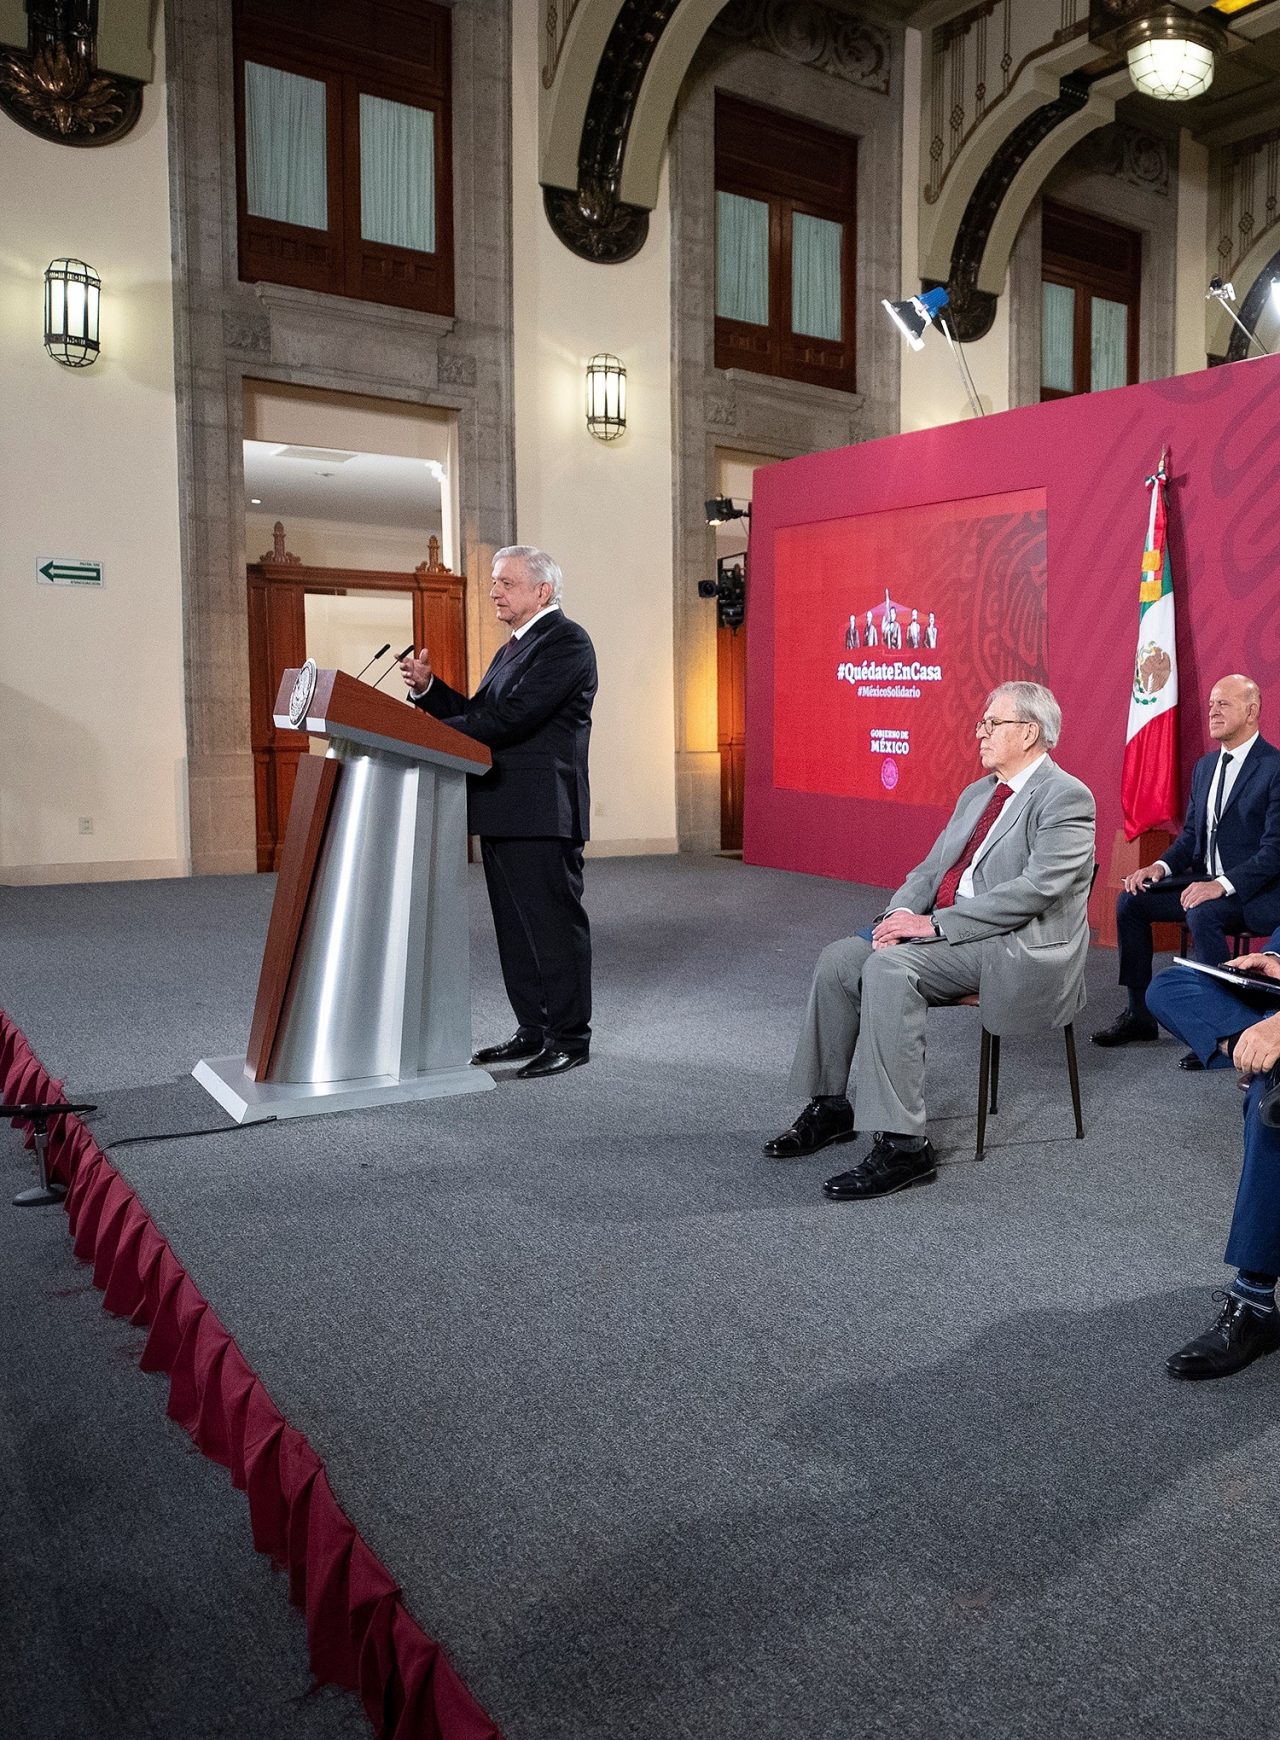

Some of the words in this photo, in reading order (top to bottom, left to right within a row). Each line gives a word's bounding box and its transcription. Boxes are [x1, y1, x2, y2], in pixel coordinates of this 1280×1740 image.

[837, 660, 942, 684] #QuédateEnCasa
[857, 685, 921, 698] #MéxicoSolidario
[870, 729, 900, 739] GOBIERNO
[901, 730, 909, 740] DE
[871, 737, 909, 755] MÉXICO
